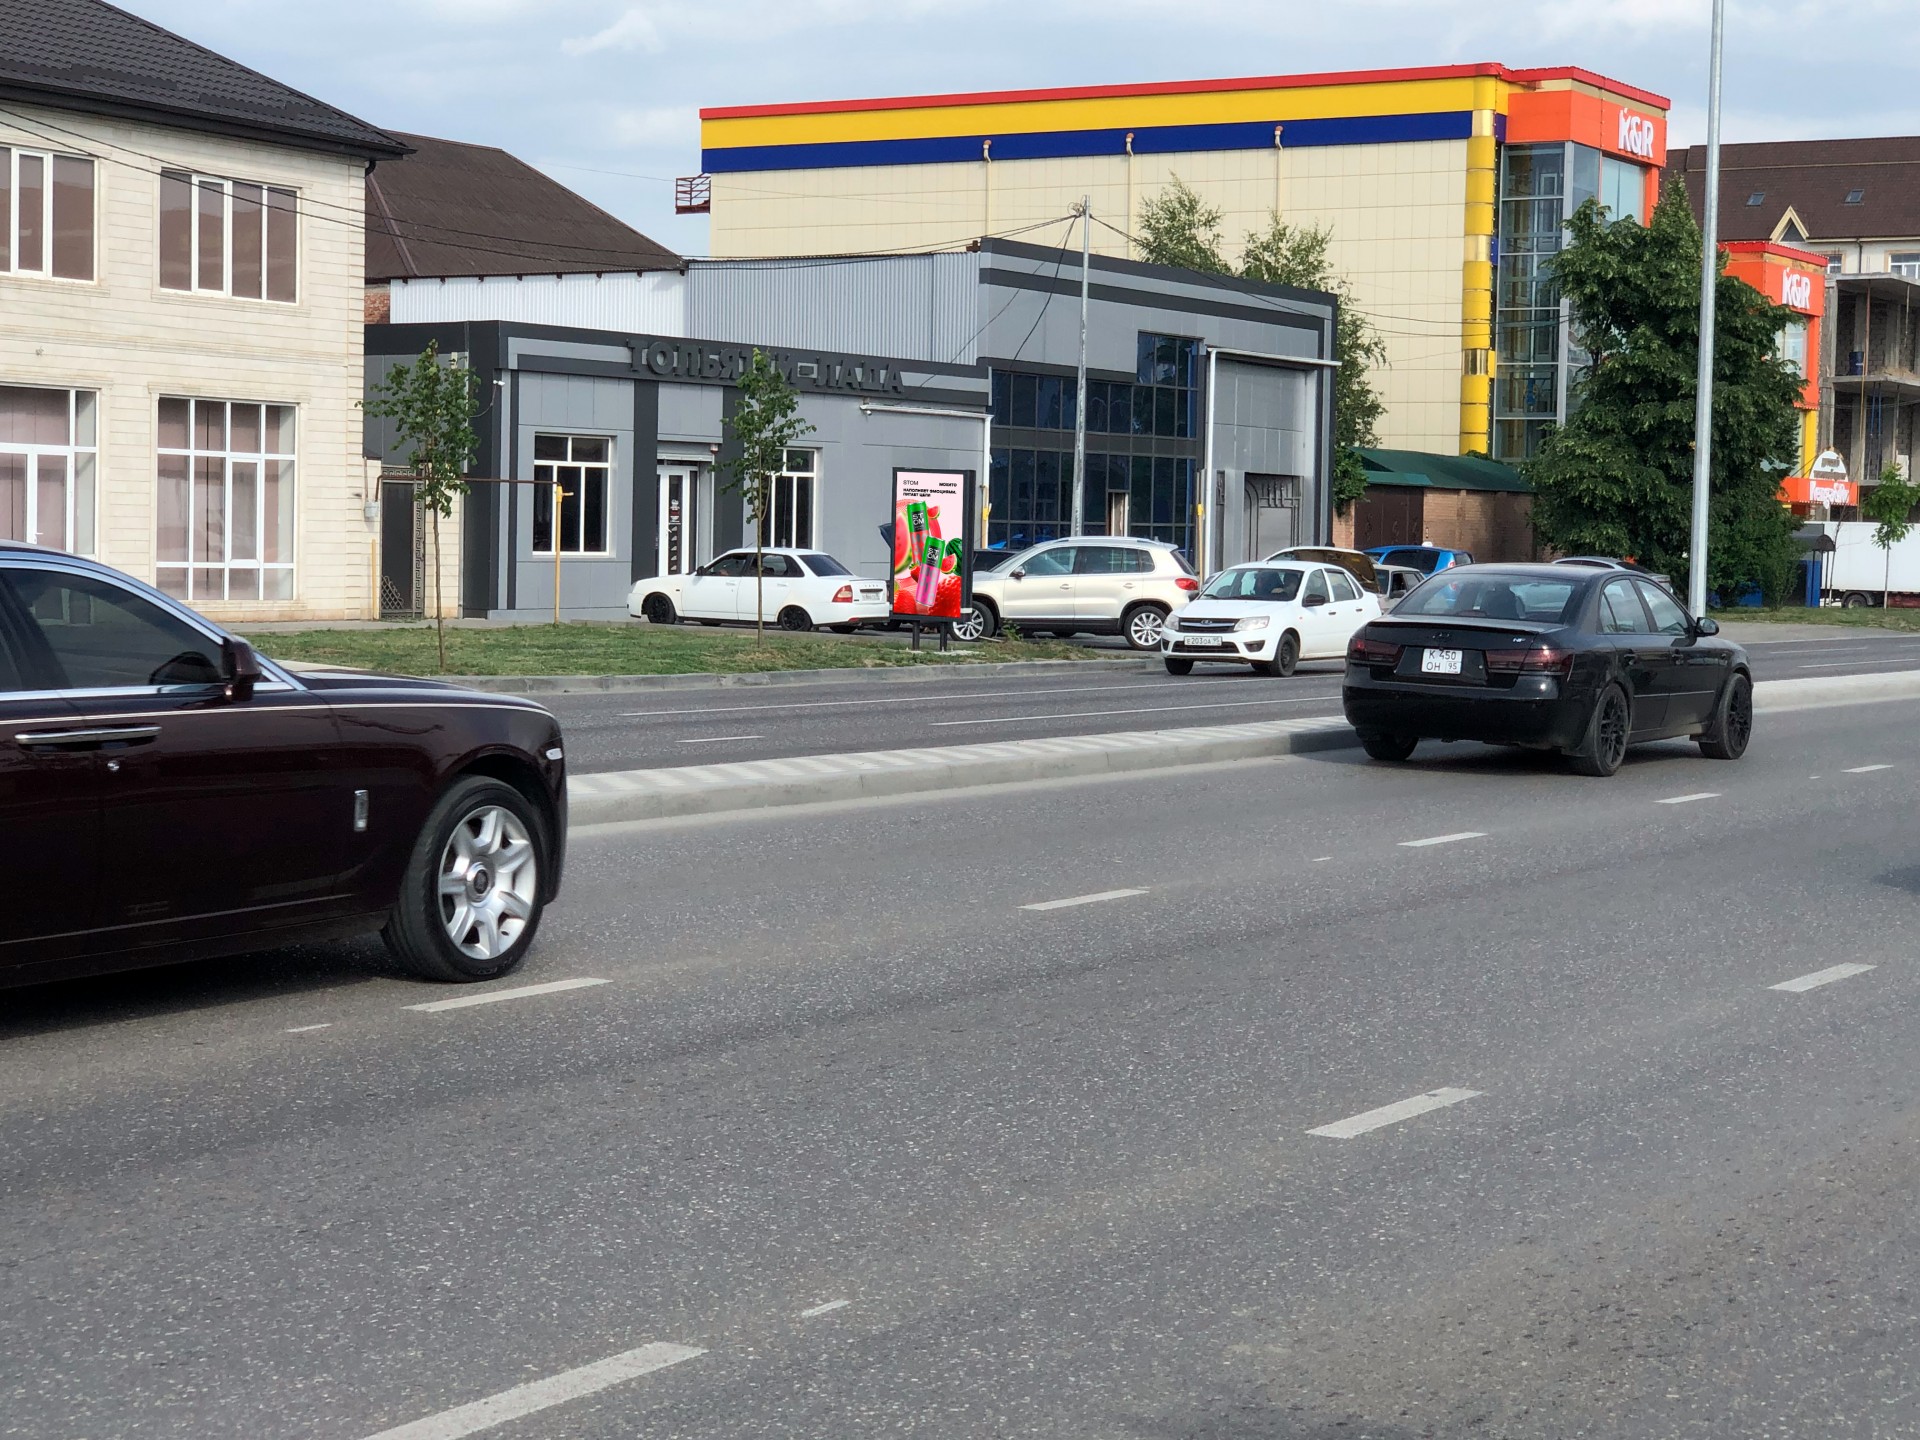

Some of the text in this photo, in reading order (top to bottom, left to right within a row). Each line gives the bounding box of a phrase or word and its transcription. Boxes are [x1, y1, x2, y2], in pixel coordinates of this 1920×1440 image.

[1618, 108, 1654, 158] K&R
[1782, 267, 1810, 310] K&R
[625, 339, 903, 394] ТОЛЬЯТИ-ЛАДА
[1439, 650, 1457, 660] 450
[1448, 662, 1457, 670] 95
